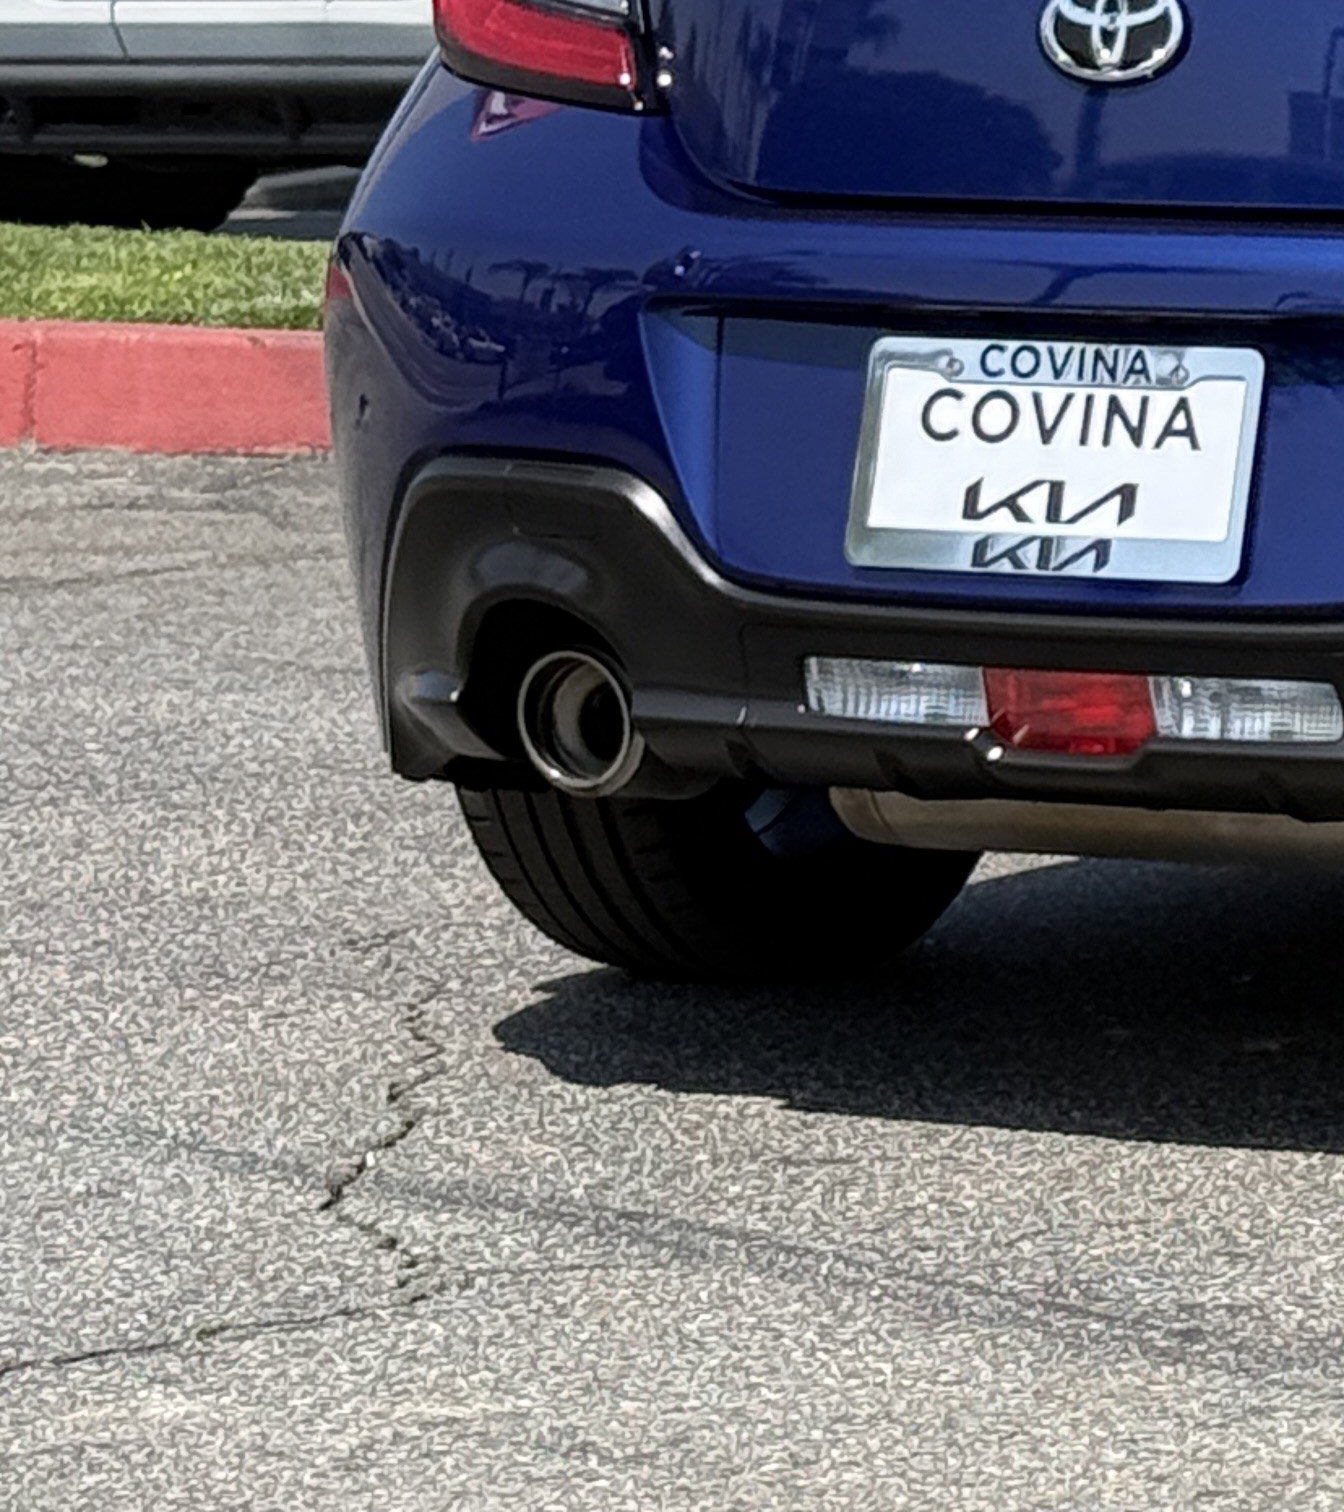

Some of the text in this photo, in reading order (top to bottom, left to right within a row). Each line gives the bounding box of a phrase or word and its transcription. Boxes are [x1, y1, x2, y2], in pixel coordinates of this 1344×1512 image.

[979, 343, 1152, 384] COVINA
[921, 387, 1201, 451] COVINA
[962, 477, 1139, 527] KIA
[971, 533, 1112, 574] KIA
